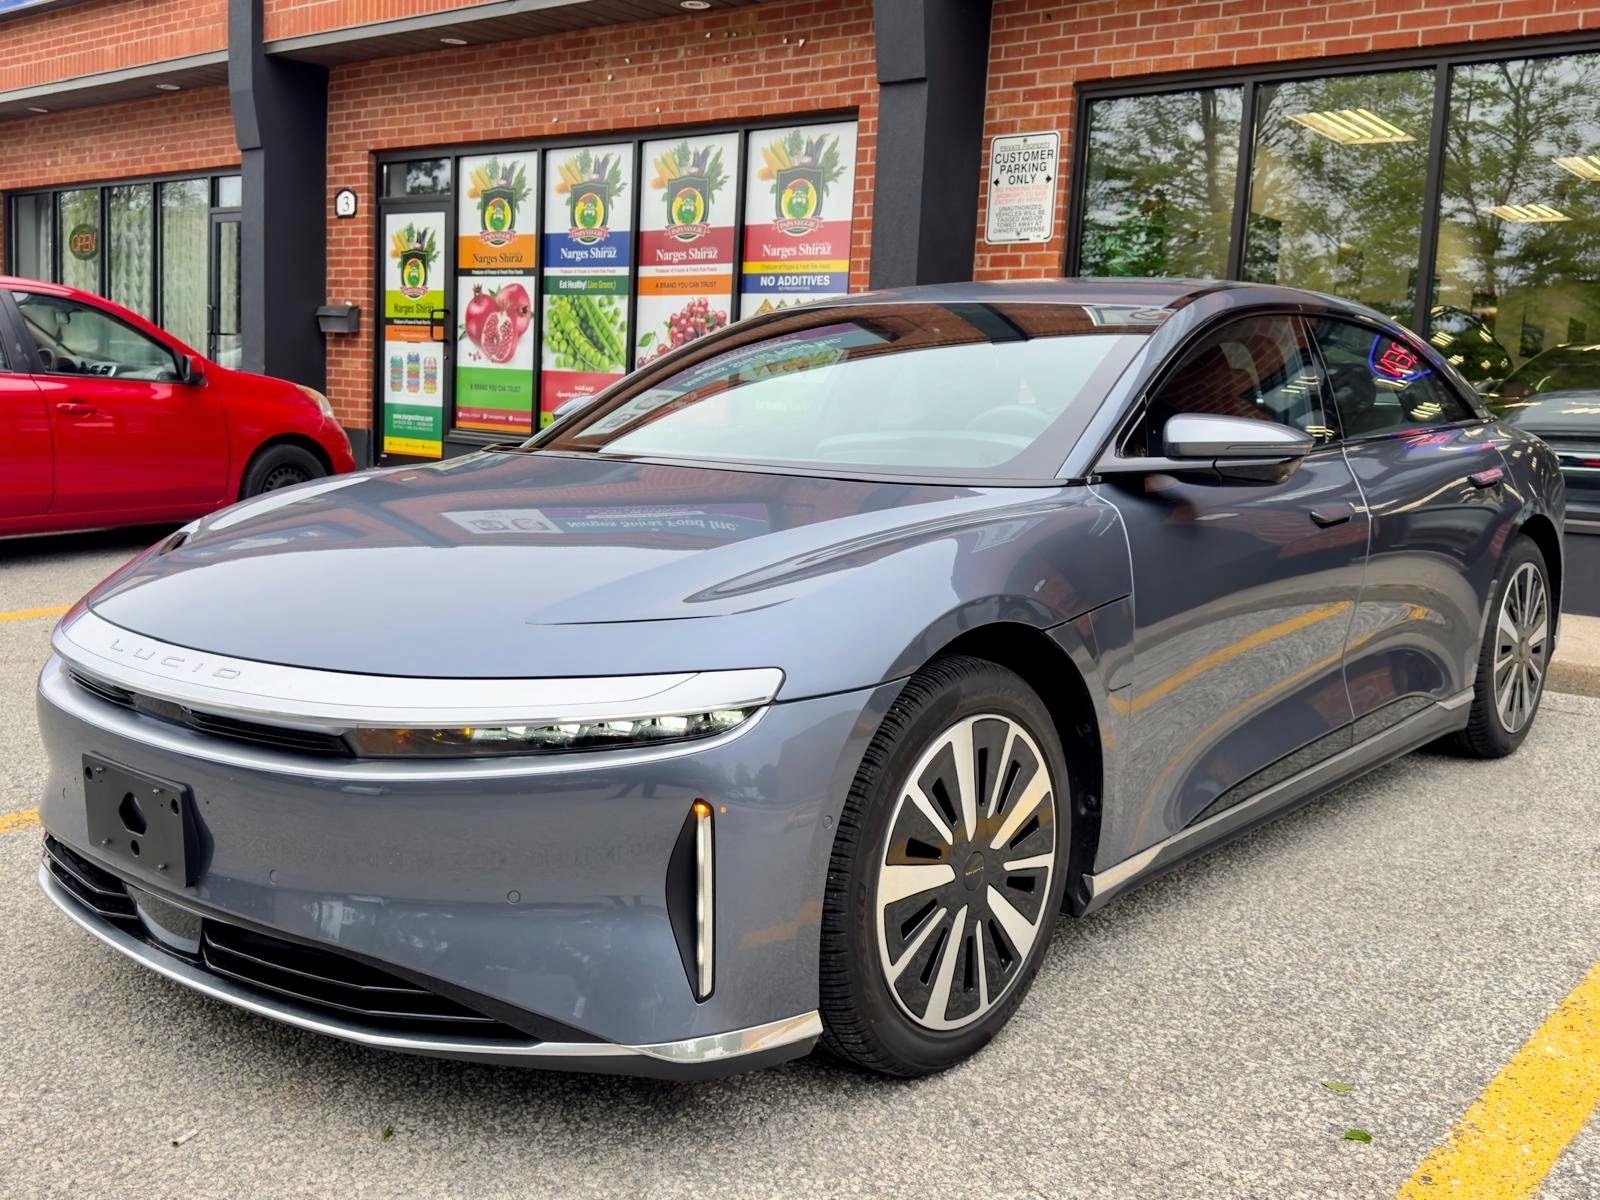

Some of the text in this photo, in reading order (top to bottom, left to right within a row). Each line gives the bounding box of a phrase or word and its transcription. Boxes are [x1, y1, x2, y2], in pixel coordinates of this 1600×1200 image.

[1000, 144, 1021, 152] PRIVATE
[994, 149, 1054, 164] CUSTOMER
[999, 162, 1047, 174] PARKING
[1008, 174, 1037, 185] ONLY
[343, 195, 350, 212] 3
[72, 233, 96, 252] OPEN
[560, 247, 617, 262] Narges Shiraz
[656, 247, 718, 263] Narges Shiraz
[762, 242, 832, 259] Narges Shiraz
[472, 252, 523, 265] Narges Shiraz
[559, 280, 567, 289] Eat
[588, 280, 598, 289] Live
[760, 275, 830, 286] NO ADDITIVES
[393, 304, 414, 315] Narges
[110, 639, 241, 680] LUCID
